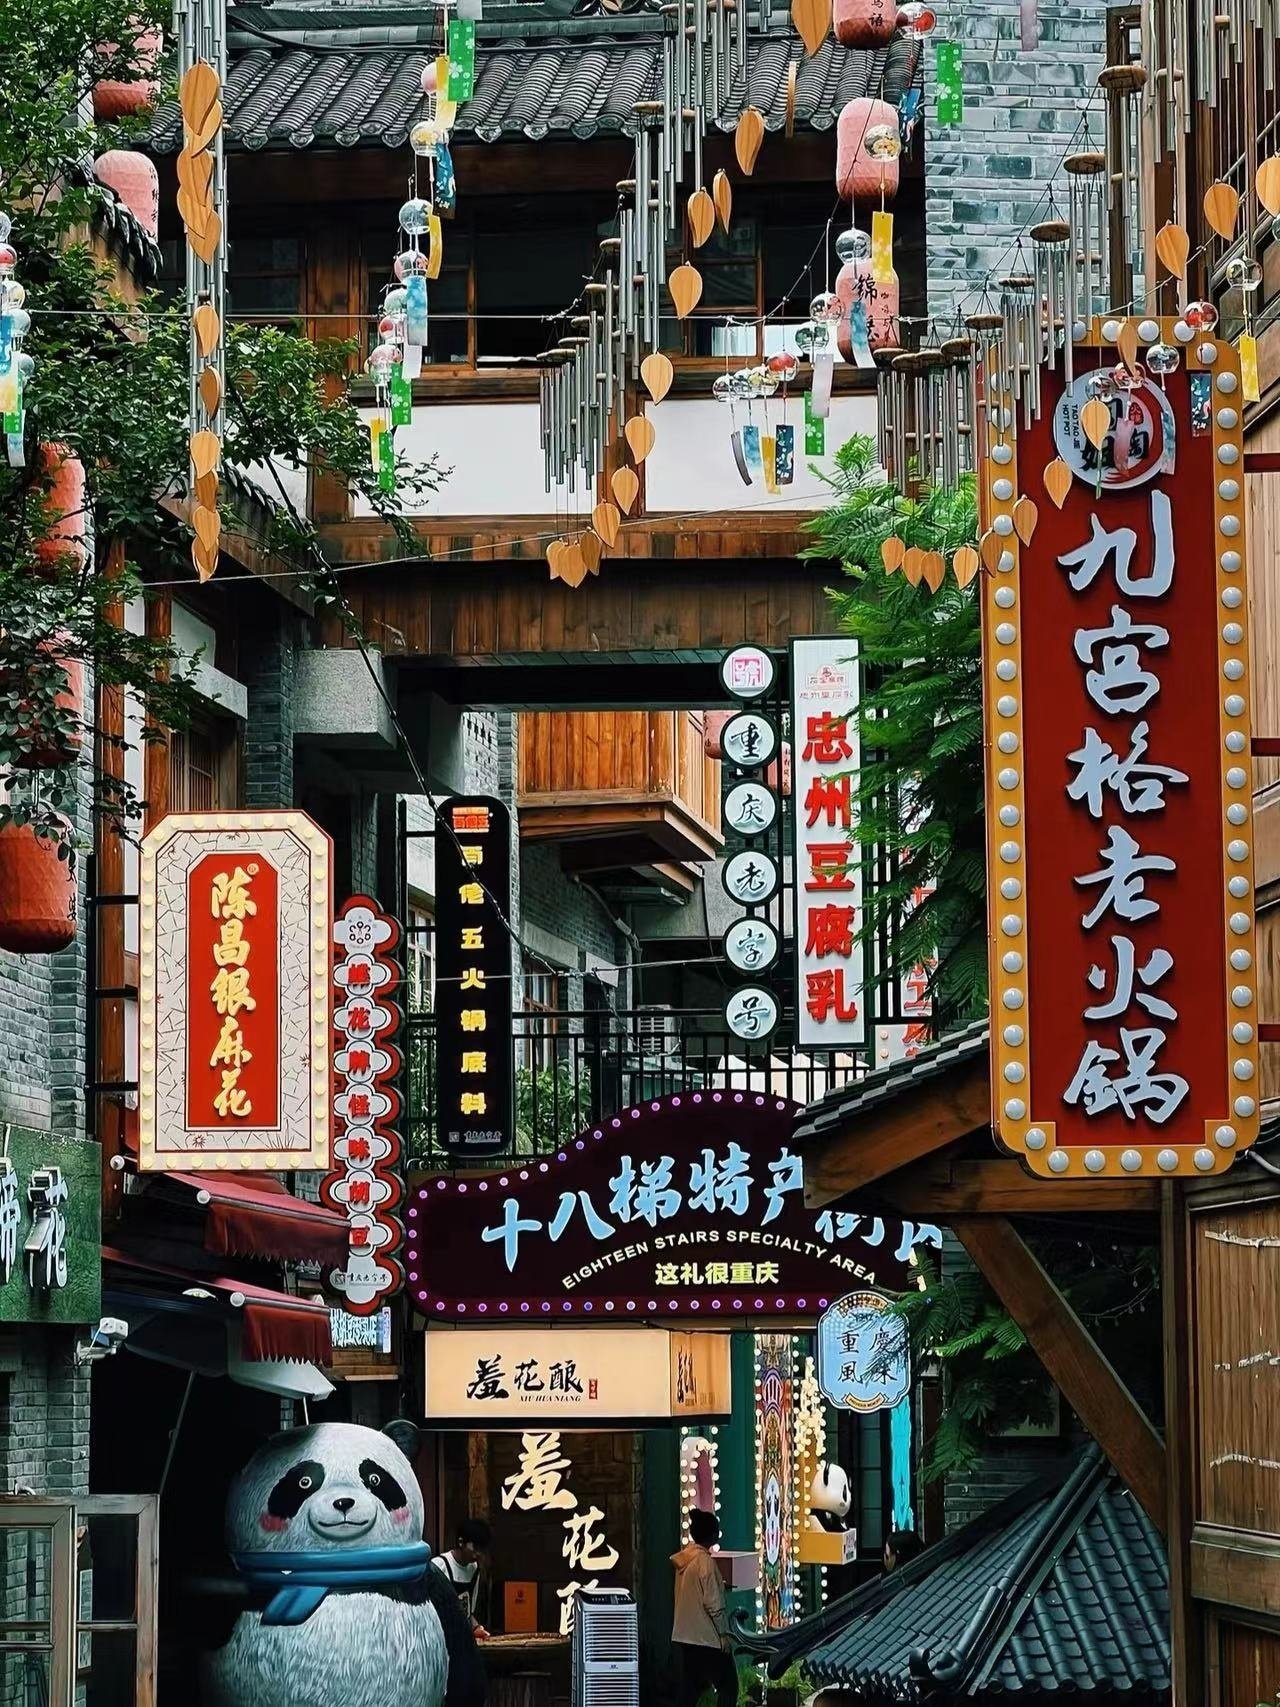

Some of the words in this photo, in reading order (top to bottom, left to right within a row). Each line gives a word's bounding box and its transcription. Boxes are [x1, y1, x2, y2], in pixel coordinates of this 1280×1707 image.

[1062, 404, 1070, 420] HOT
[1071, 404, 1079, 420] TAO
[1063, 421, 1071, 437] POT
[1072, 421, 1080, 437] TAO
[731, 722, 770, 1032] 重庆老字号
[802, 711, 858, 1022] 忠州豆腐乳
[561, 1241, 649, 1290] EIGHTEEN
[654, 1230, 720, 1250] STAIRS
[726, 1229, 829, 1259] SPECIALTY
[828, 1253, 877, 1286] AREA
[655, 1261, 780, 1286] 这礼很重庆
[466, 1353, 584, 1401] 羞花酿
